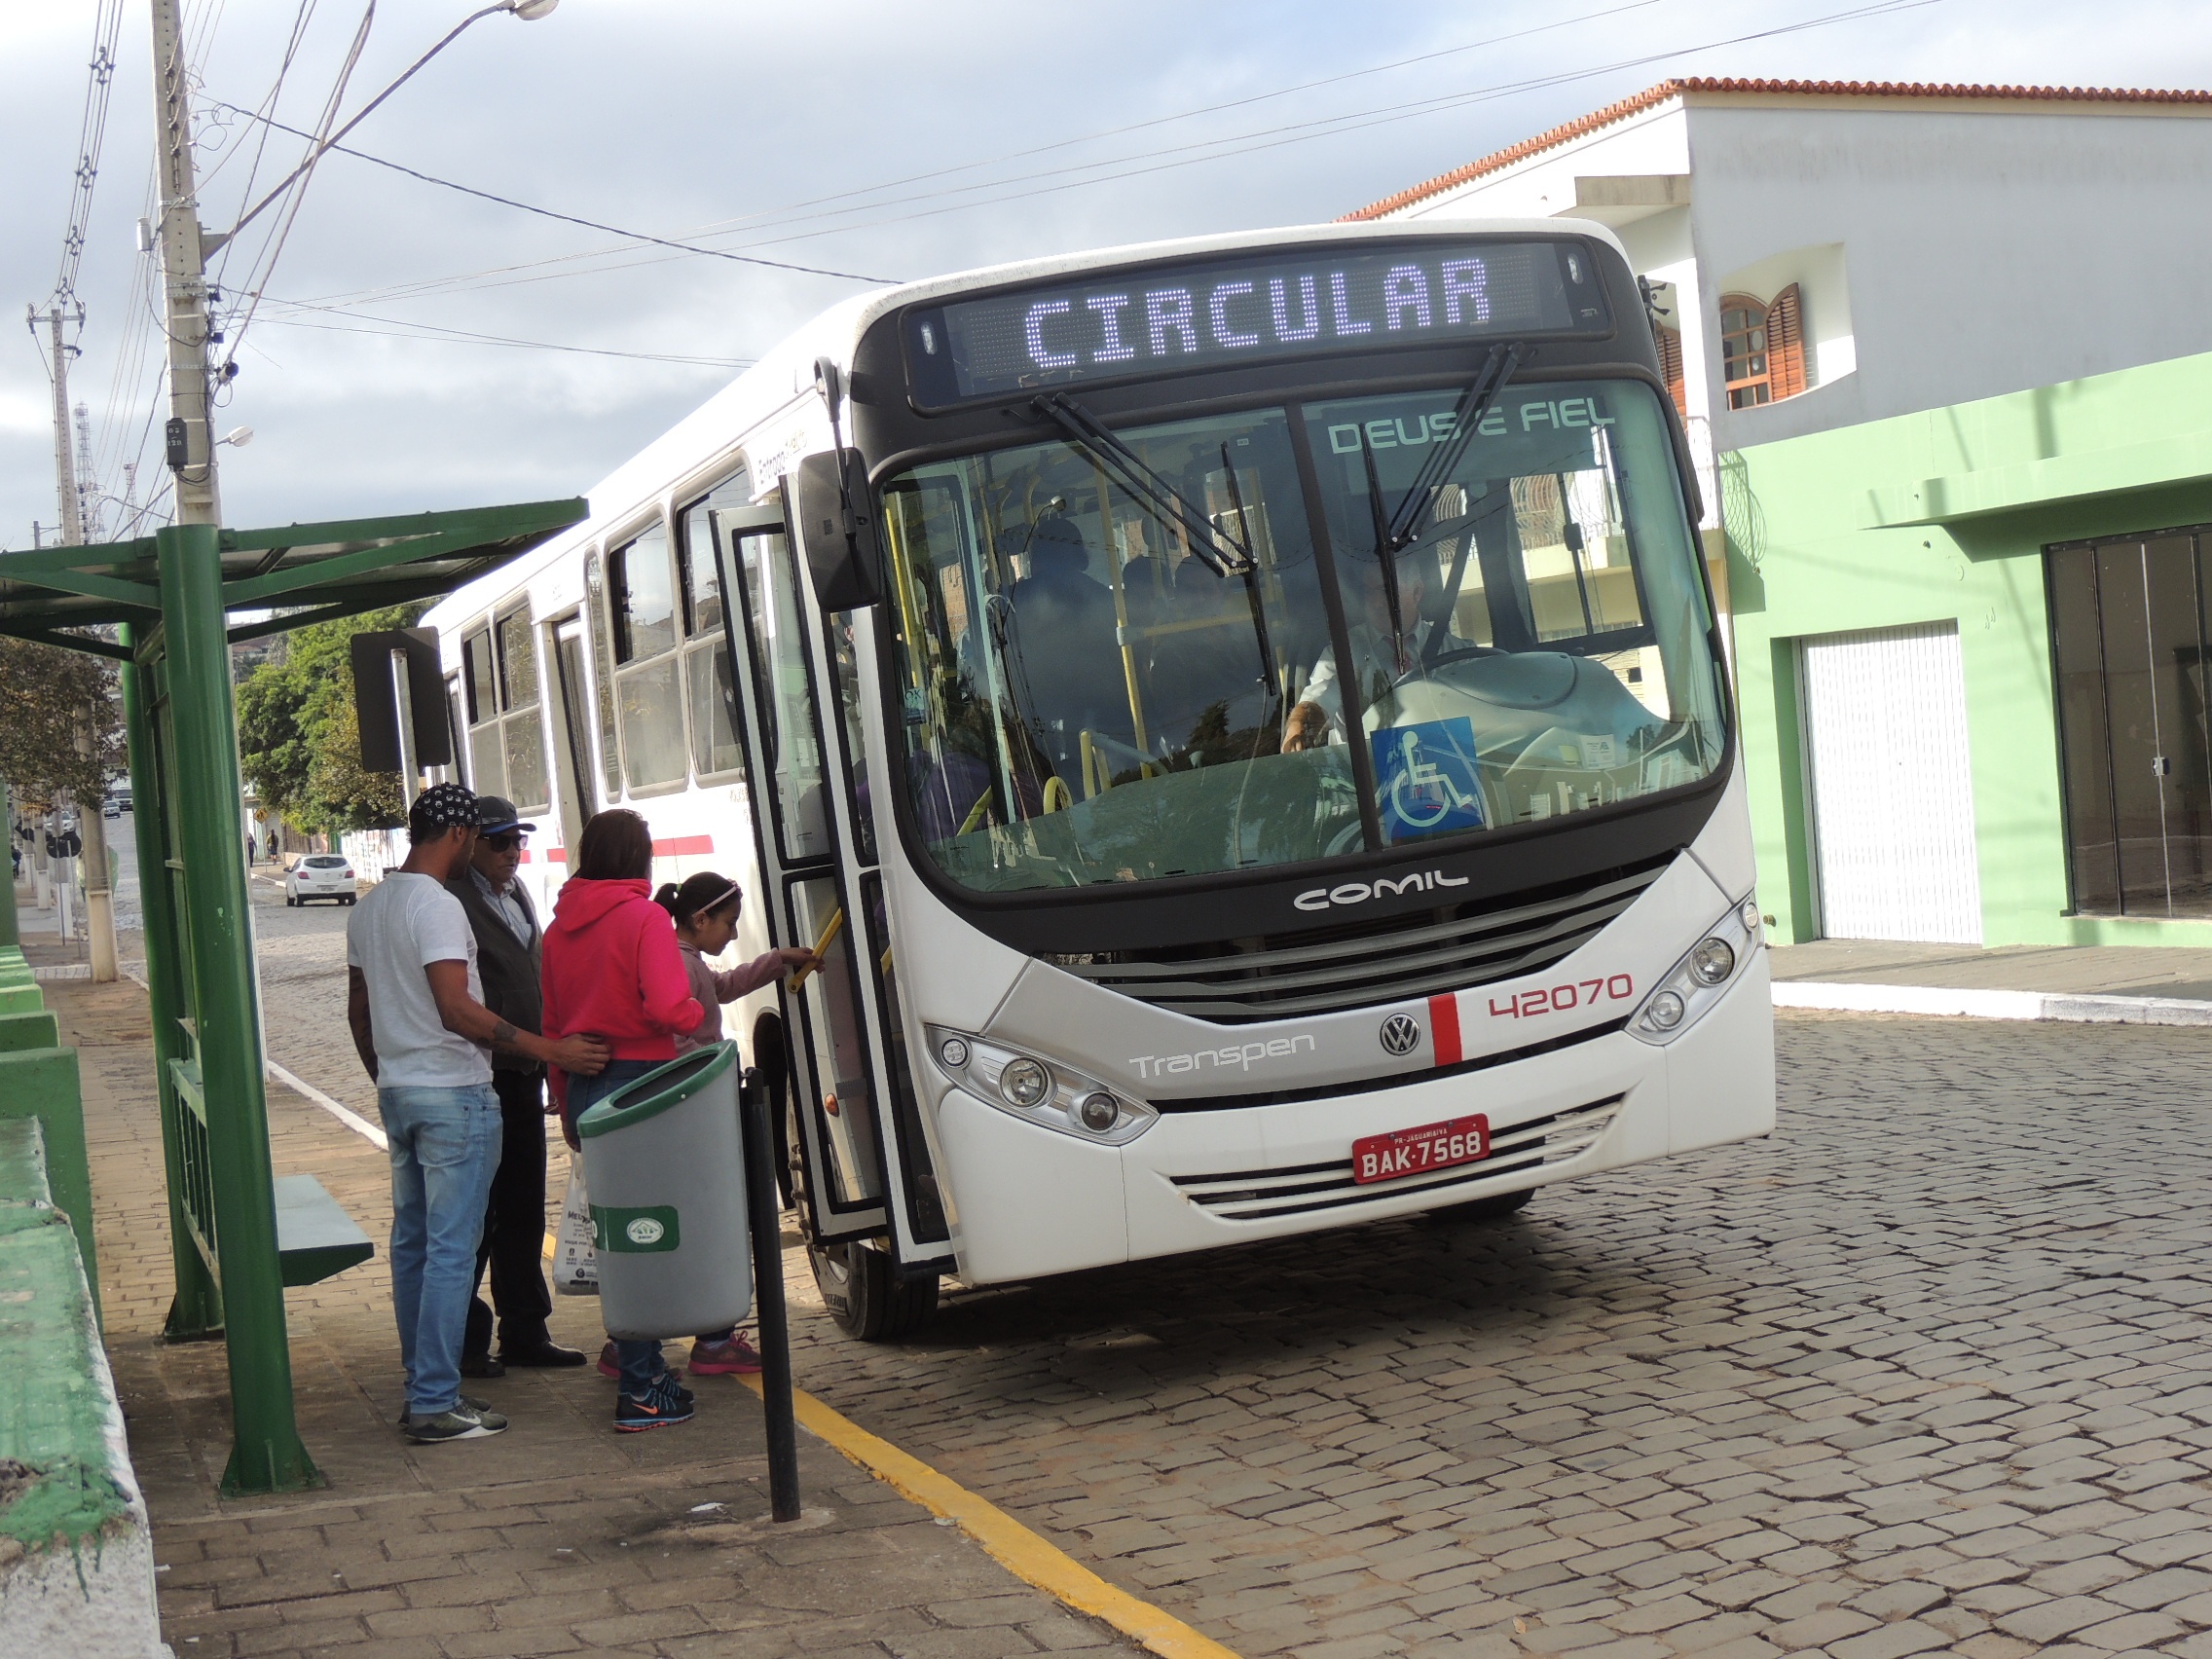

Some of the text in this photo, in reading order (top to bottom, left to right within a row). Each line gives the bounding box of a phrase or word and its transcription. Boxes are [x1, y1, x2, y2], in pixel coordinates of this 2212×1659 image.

[1024, 258, 1491, 368] CIRCULAR
[1327, 396, 1616, 455] DEUS E FIEL
[1293, 869, 1470, 911] COMIL
[1488, 973, 1634, 1019] 42070
[1128, 1034, 1315, 1079] Transpen
